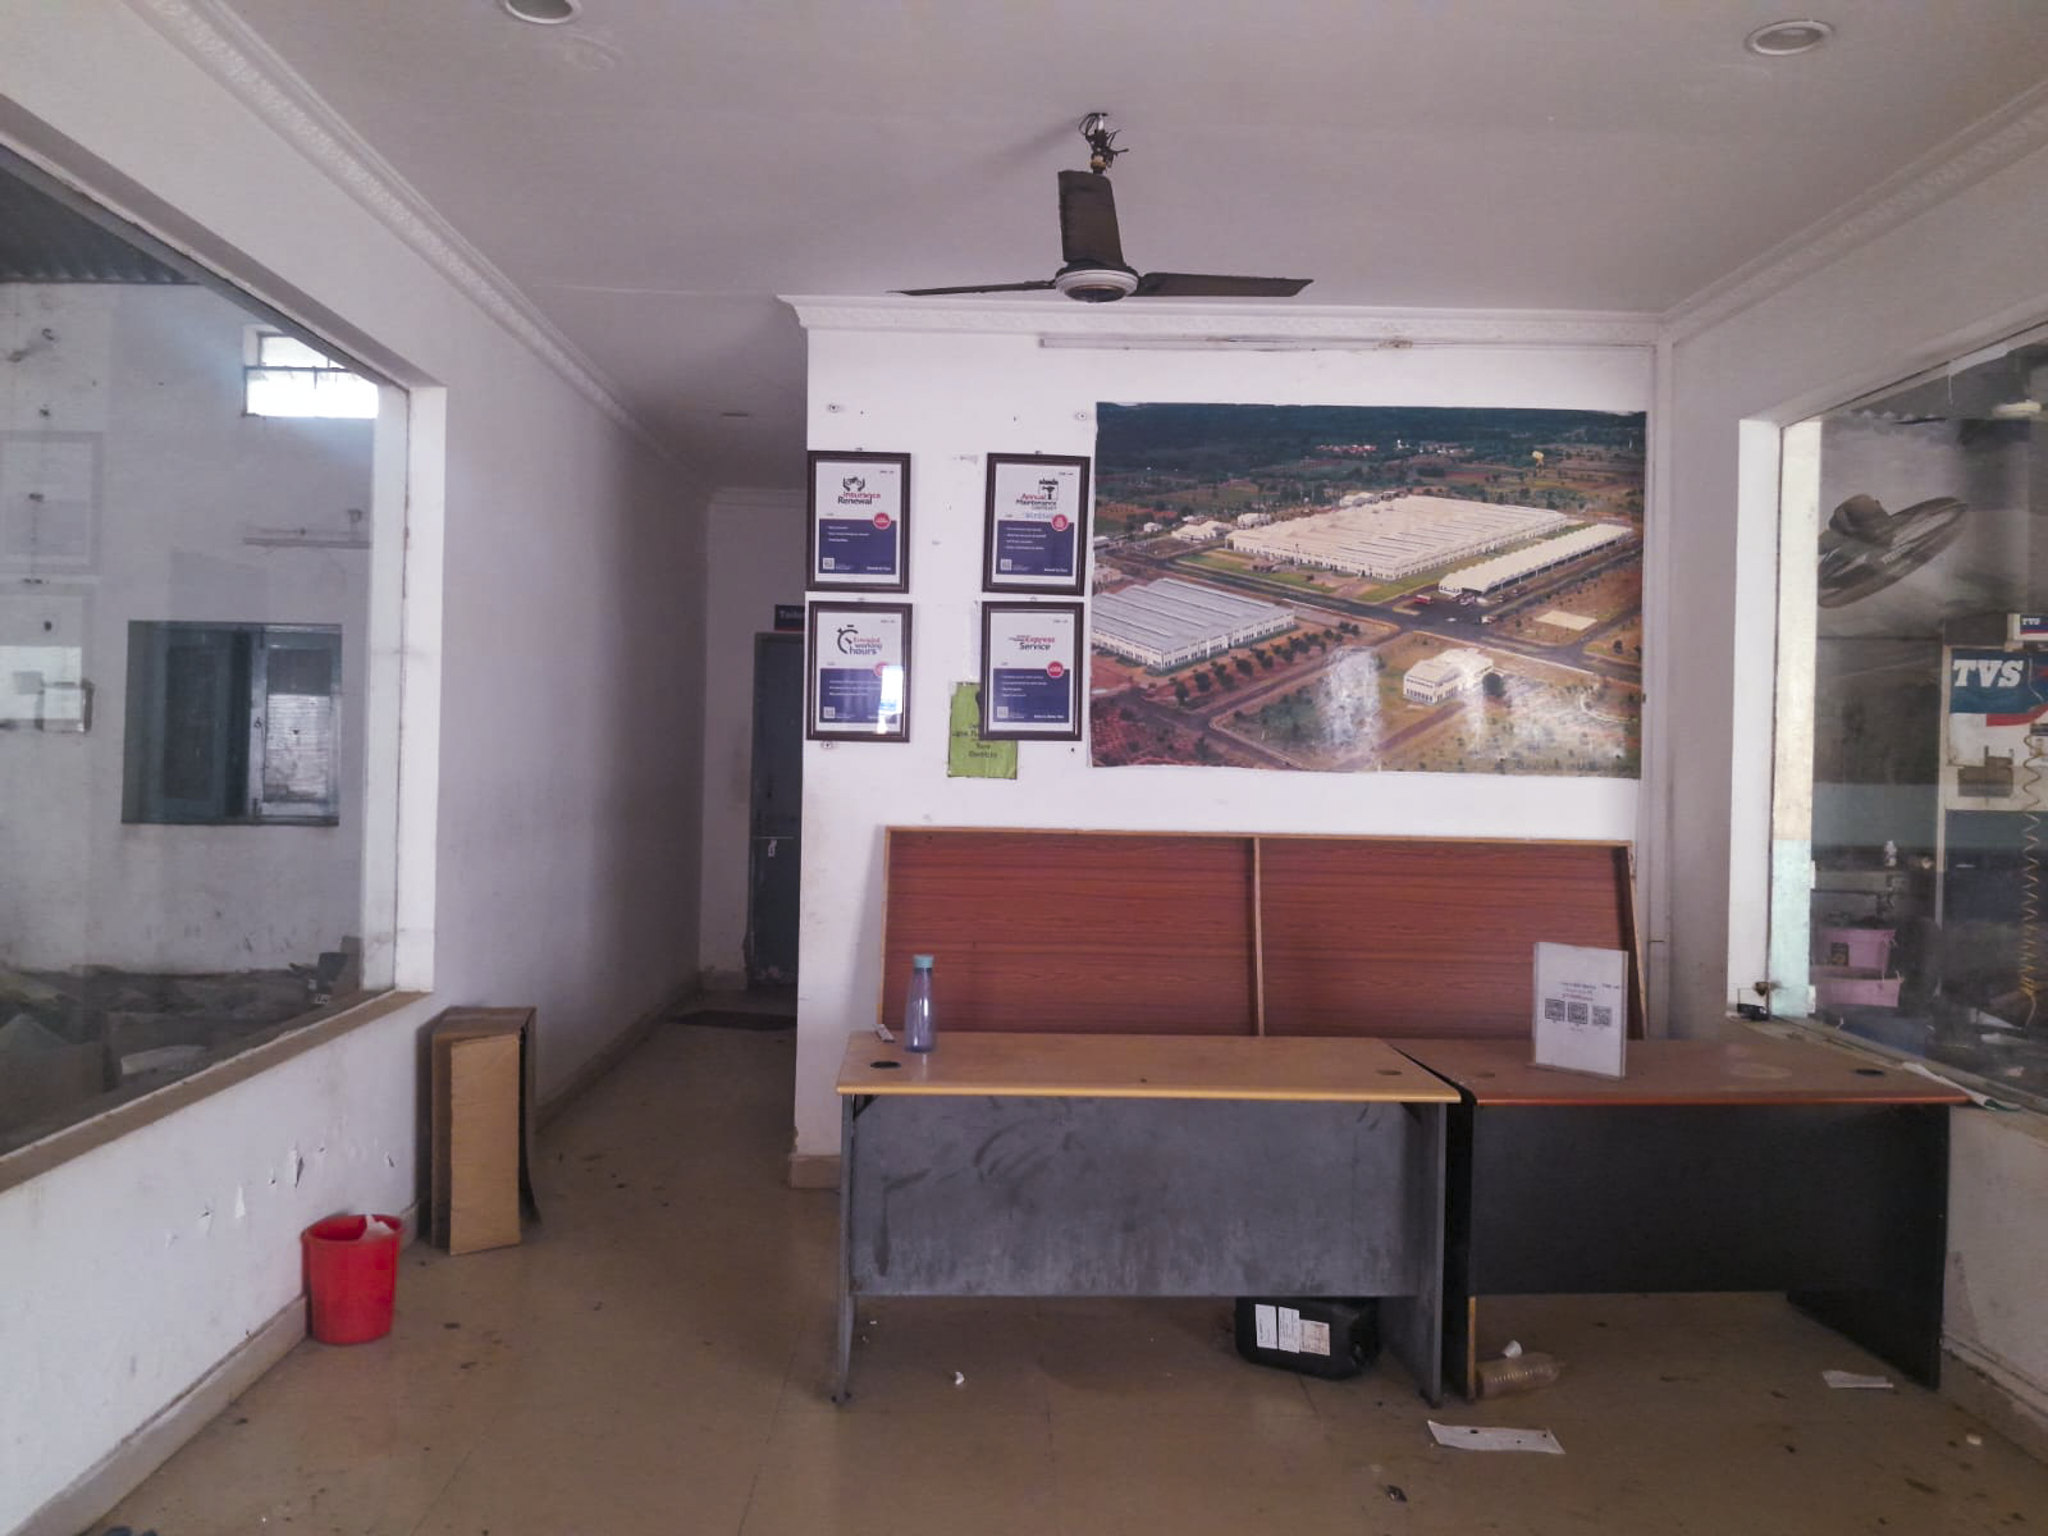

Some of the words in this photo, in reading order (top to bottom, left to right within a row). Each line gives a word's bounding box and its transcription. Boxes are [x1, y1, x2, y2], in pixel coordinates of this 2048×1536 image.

[838, 496, 872, 505] Renewal
[2022, 617, 2041, 626] TVS
[849, 645, 878, 655] hours
[1019, 642, 1051, 650] Service
[1952, 659, 2025, 687] TVS
